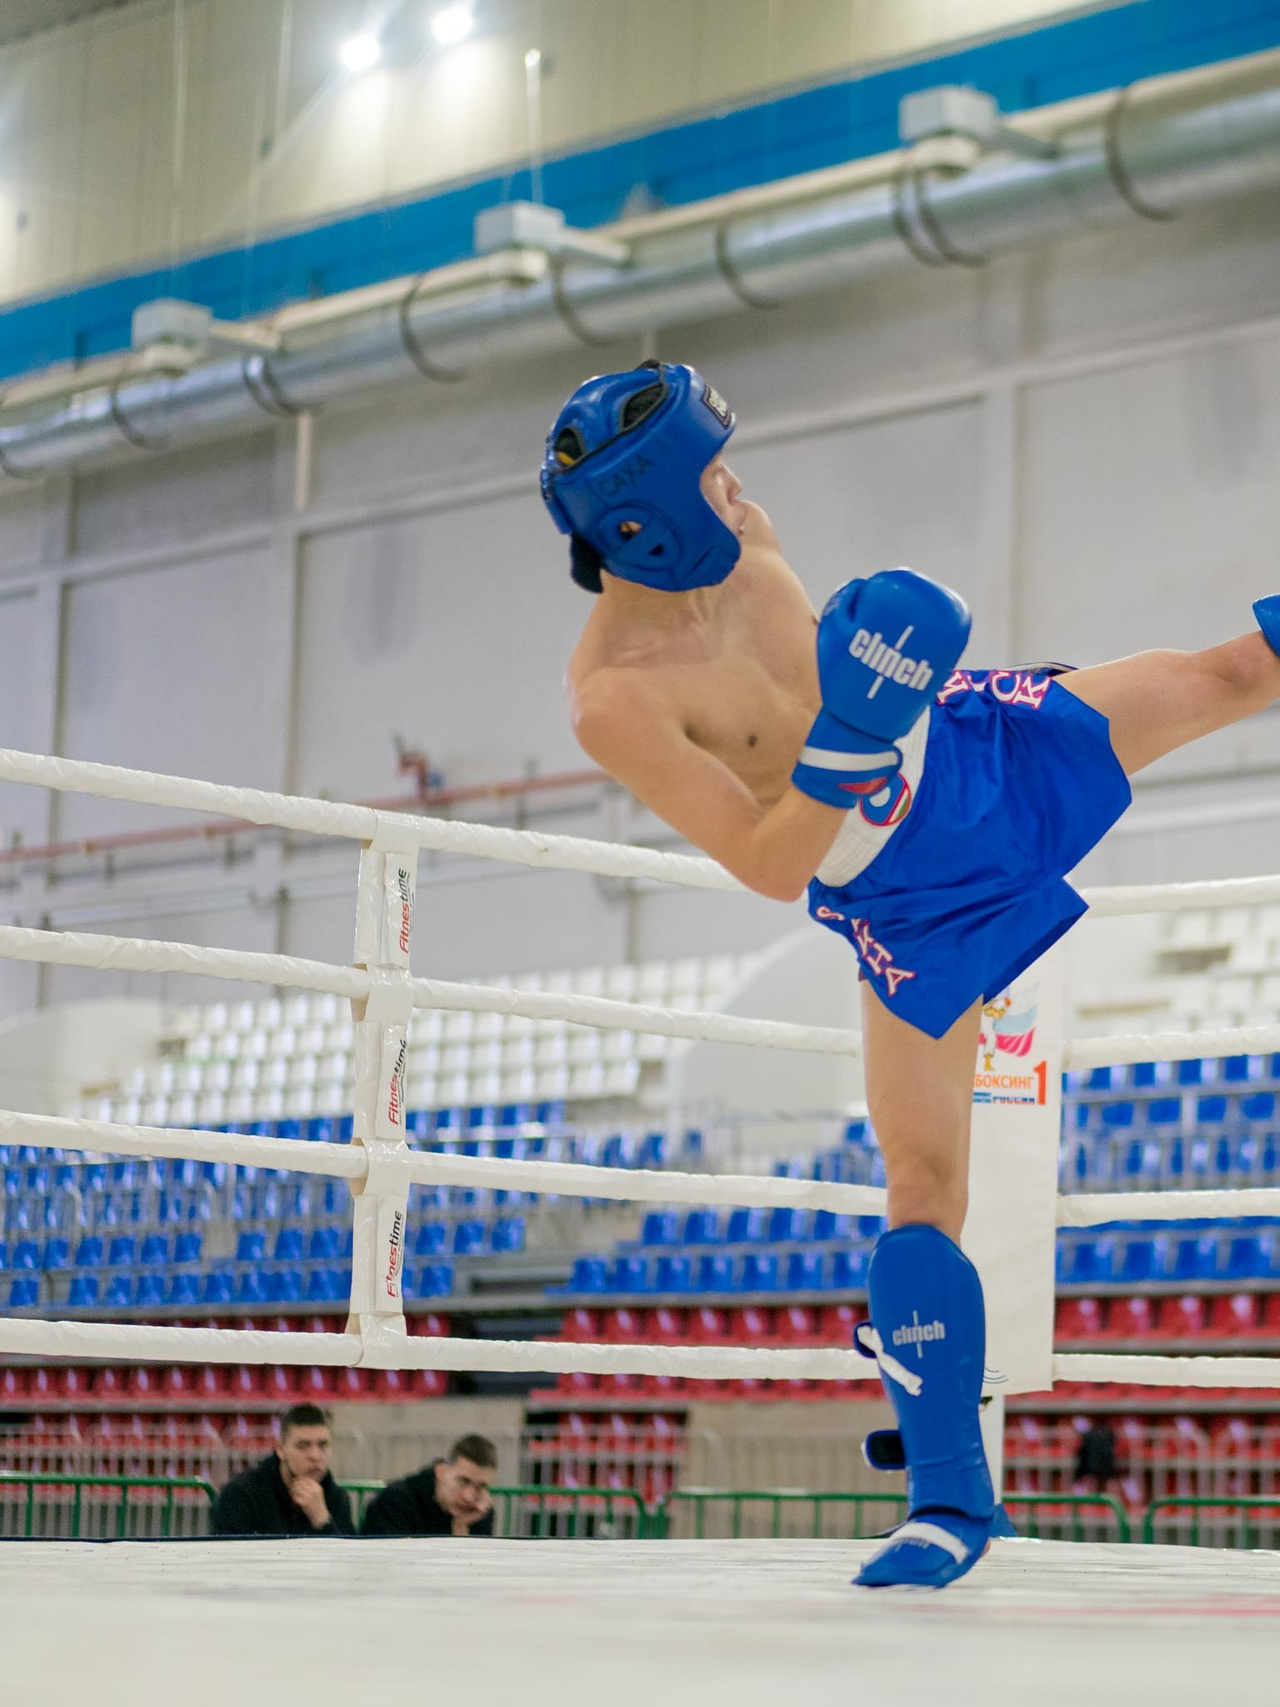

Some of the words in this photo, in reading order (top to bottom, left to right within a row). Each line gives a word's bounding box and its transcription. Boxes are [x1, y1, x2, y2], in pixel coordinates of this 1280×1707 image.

[848, 628, 934, 691] clinch
[398, 868, 410, 954] Fitnestime
[1033, 1060, 1047, 1106] 1
[386, 1210, 402, 1298] Ftnestime
[892, 1320, 946, 1346] clinch
